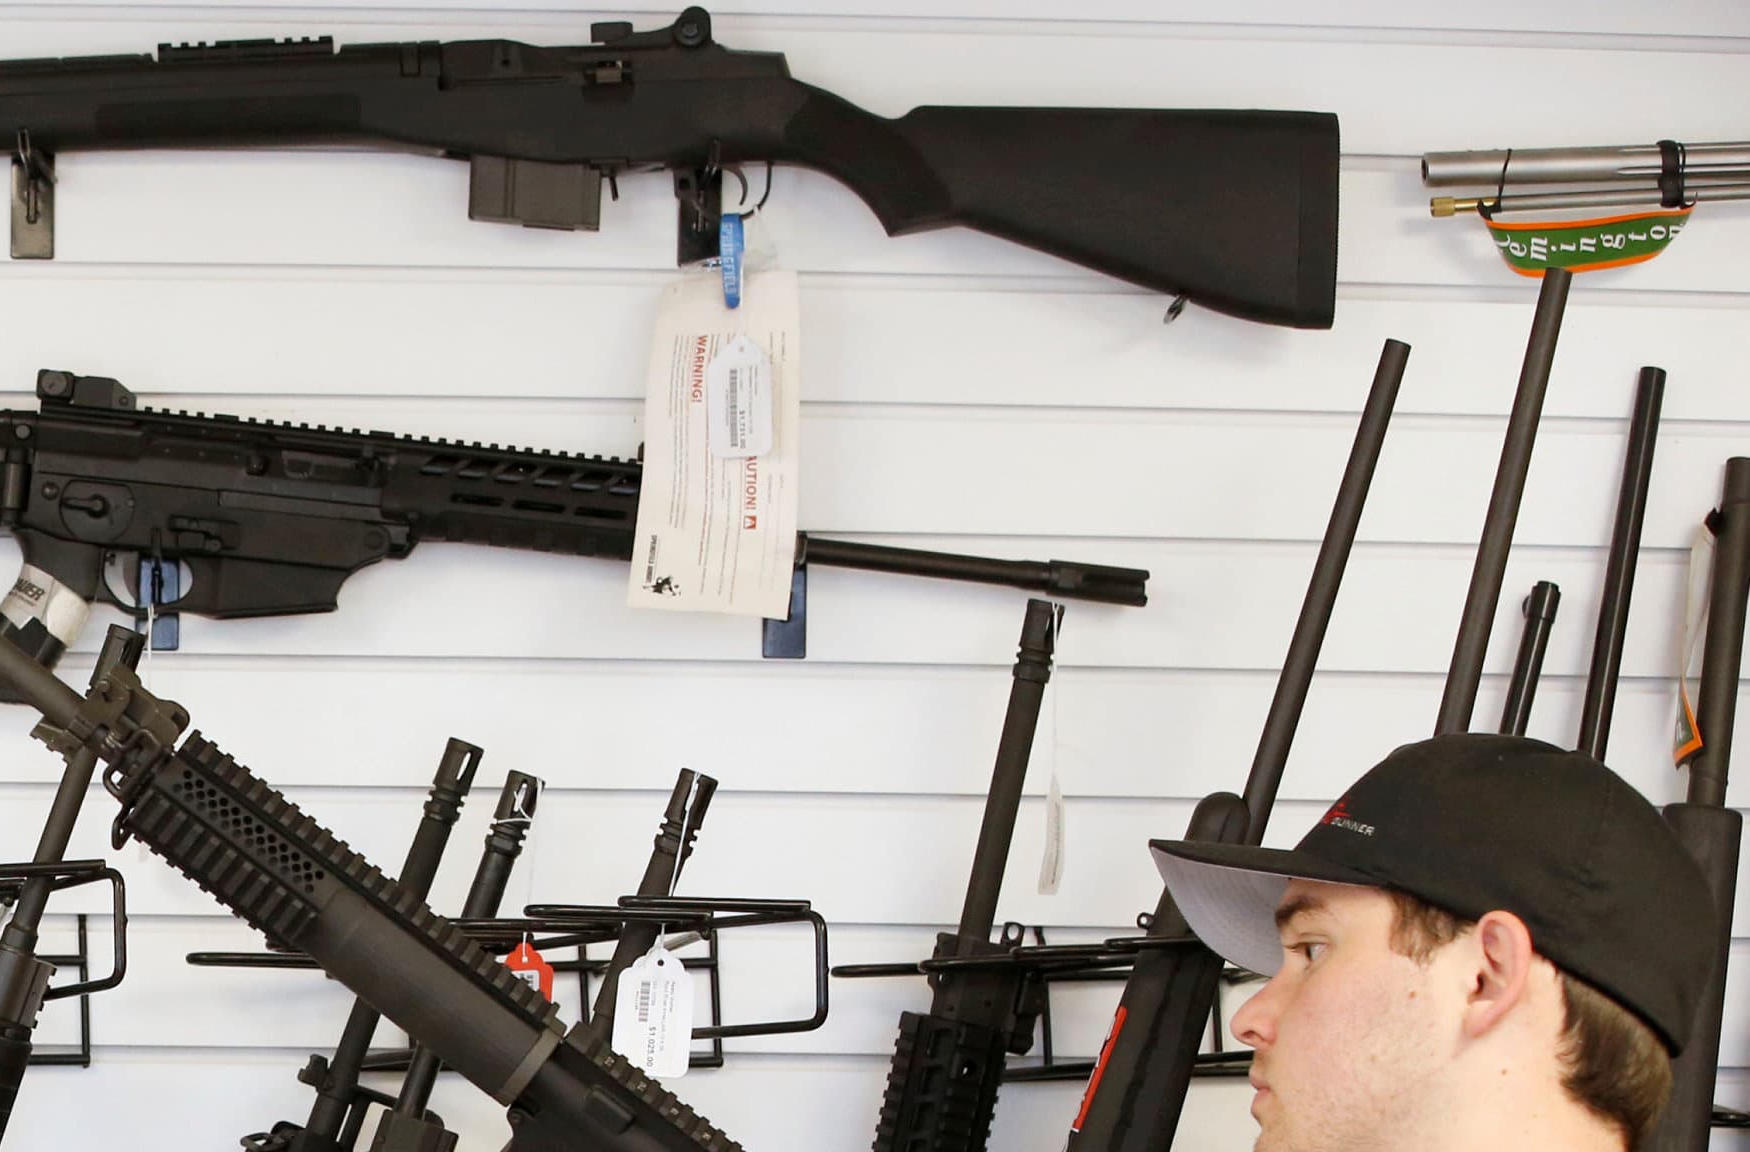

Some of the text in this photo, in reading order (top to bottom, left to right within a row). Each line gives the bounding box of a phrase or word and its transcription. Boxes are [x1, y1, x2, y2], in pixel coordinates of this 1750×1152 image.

[1497, 224, 1683, 262] emington
[690, 334, 709, 404] WARNING!
[744, 456, 758, 510] AUTION!
